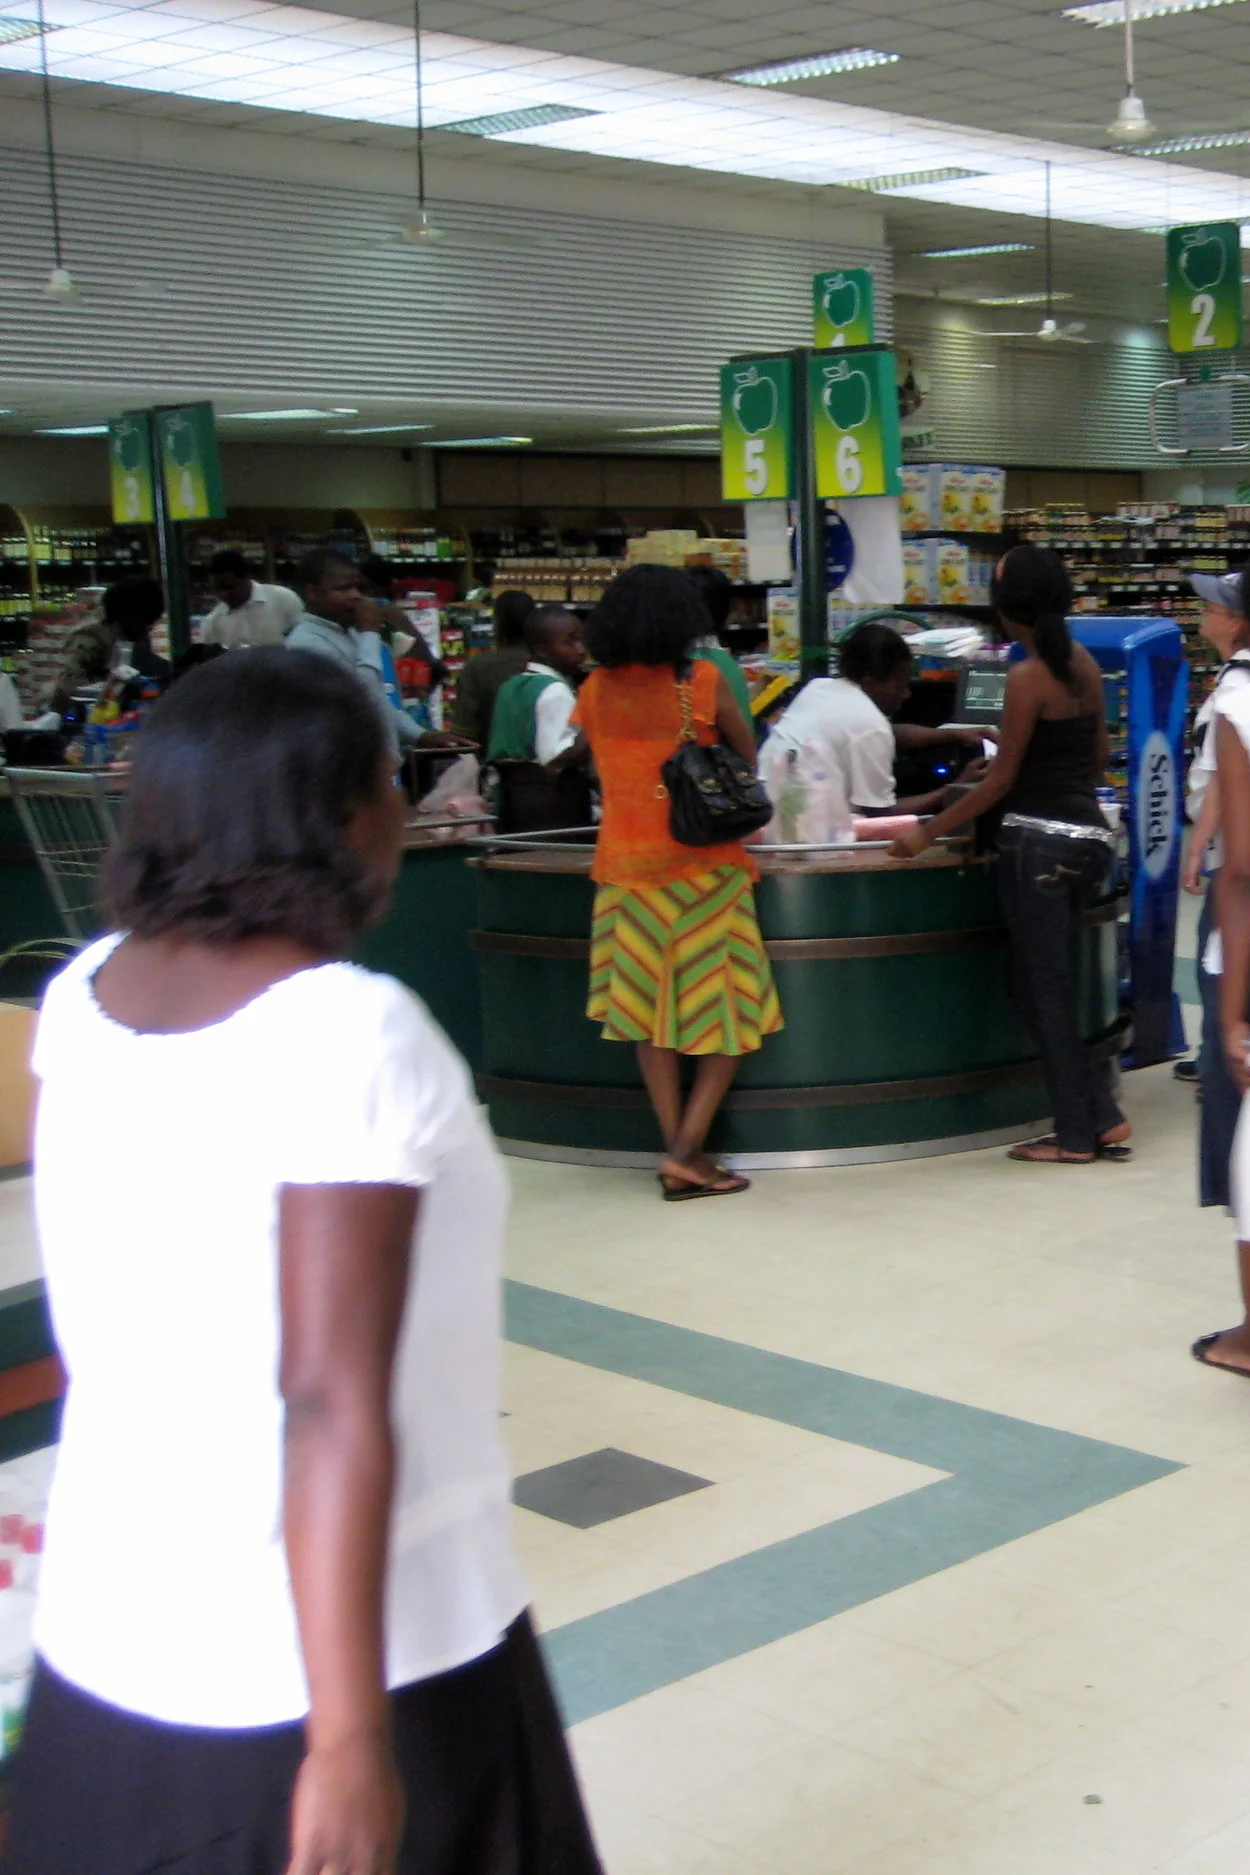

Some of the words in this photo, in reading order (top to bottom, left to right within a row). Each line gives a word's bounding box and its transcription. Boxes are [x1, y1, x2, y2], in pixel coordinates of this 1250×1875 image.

[1190, 293, 1217, 347] 2
[743, 438, 769, 496] 5
[836, 434, 863, 494] 6
[123, 477, 140, 519] 3
[1146, 753, 1169, 857] Schick
